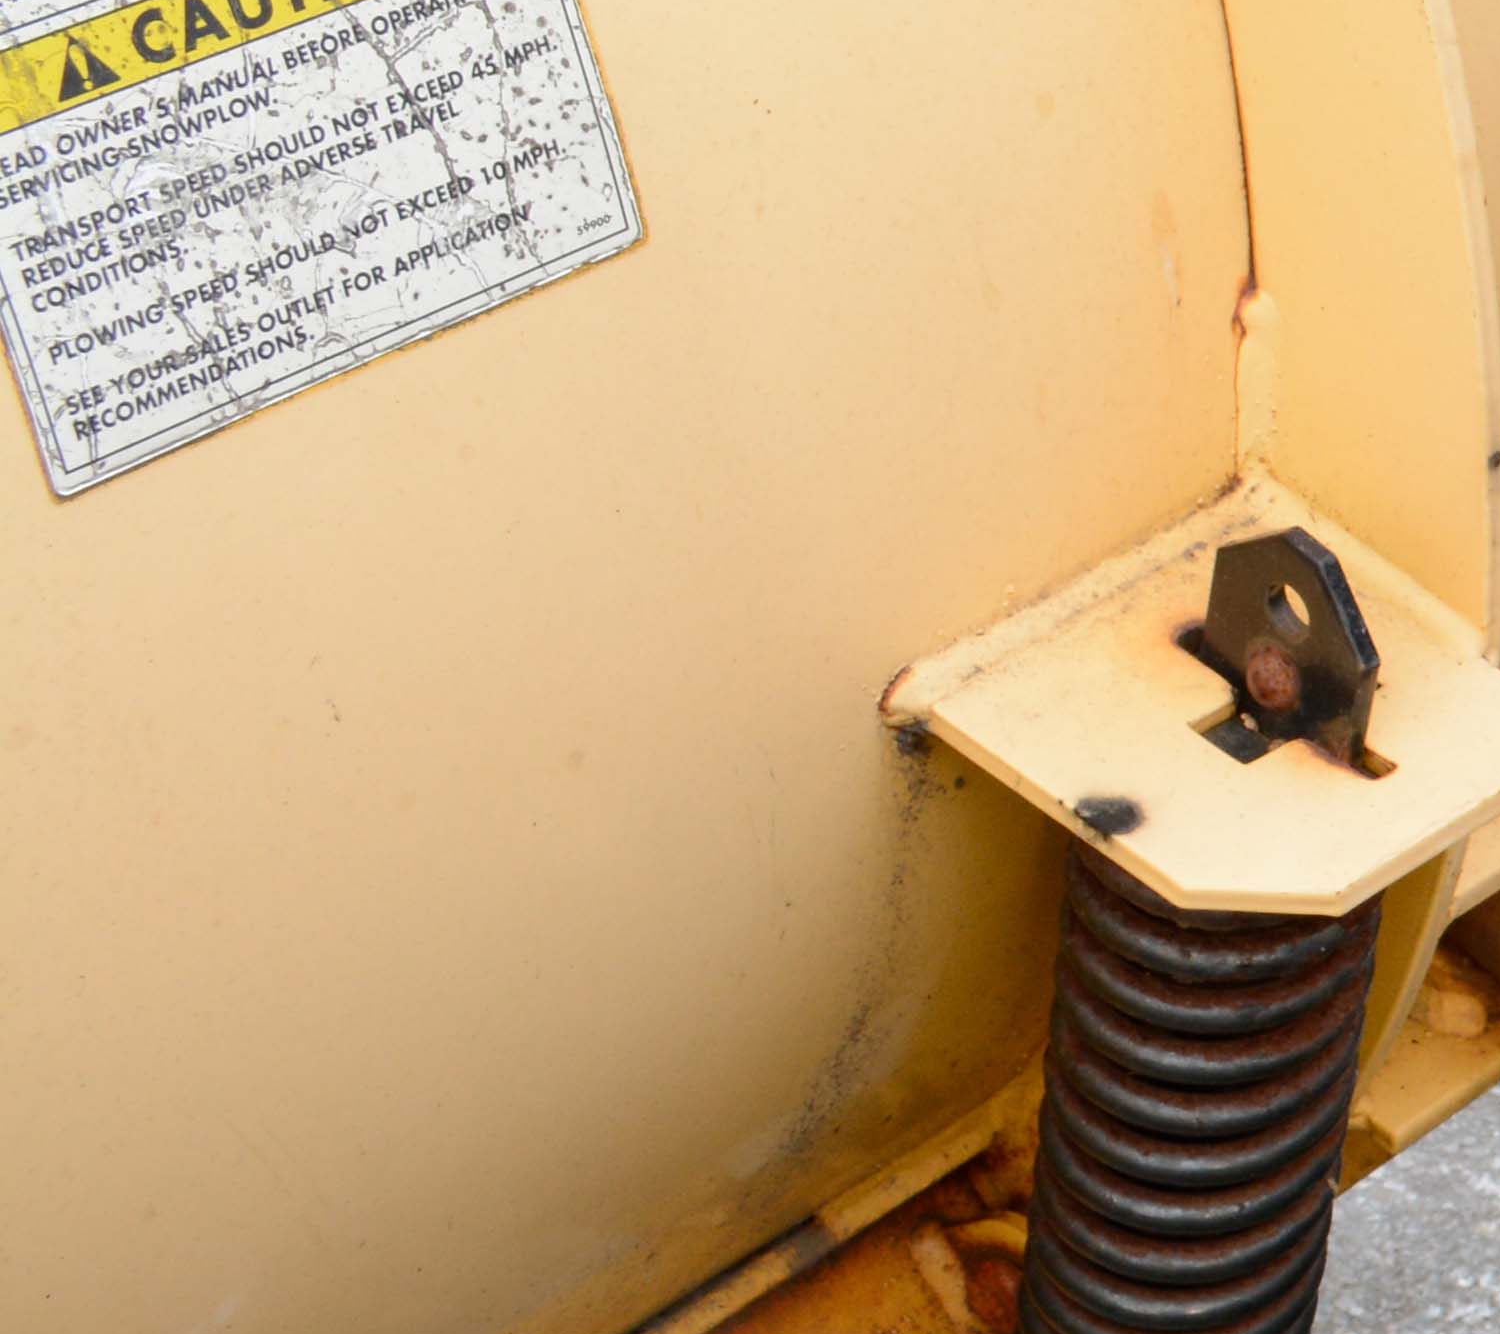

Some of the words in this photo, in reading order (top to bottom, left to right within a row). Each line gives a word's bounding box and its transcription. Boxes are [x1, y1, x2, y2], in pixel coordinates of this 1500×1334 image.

[0, 147, 120, 209] SERVICING
[127, 88, 278, 157] SNOWPLOW.
[10, 191, 152, 261] TRANSPORT
[159, 164, 227, 204] SPEED
[234, 125, 325, 174] SHOULD
[332, 102, 380, 136] NOT
[386, 71, 464, 114] EXCEED
[471, 58, 498, 81] 45
[504, 35, 558, 69] MPH.
[57, 97, 170, 155] OWNER'S
[179, 58, 279, 110] MANUAL
[282, 25, 366, 70] BEFORE
[22, 238, 113, 289] REDUCE
[118, 208, 186, 250] SPEED
[193, 172, 273, 218] UNDER
[280, 131, 377, 186] ADVERSE
[380, 101, 460, 144] TRAVEL
[48, 303, 164, 366] PLOWING
[171, 273, 238, 315] SPEED
[245, 232, 336, 283] SHOULD
[395, 176, 472, 221] EXCEED
[481, 161, 506, 183] 10
[513, 139, 567, 174] MPH.
[31, 239, 189, 313] CONDITIONS.
[65, 385, 104, 415] SEE
[110, 355, 177, 395] YOUR
[185, 324, 251, 365] SALES
[257, 286, 335, 332] OUTLET
[342, 266, 387, 297] FOR
[394, 205, 531, 276] APPLICATION
[73, 326, 315, 441] RECOMMENDATIONS.
